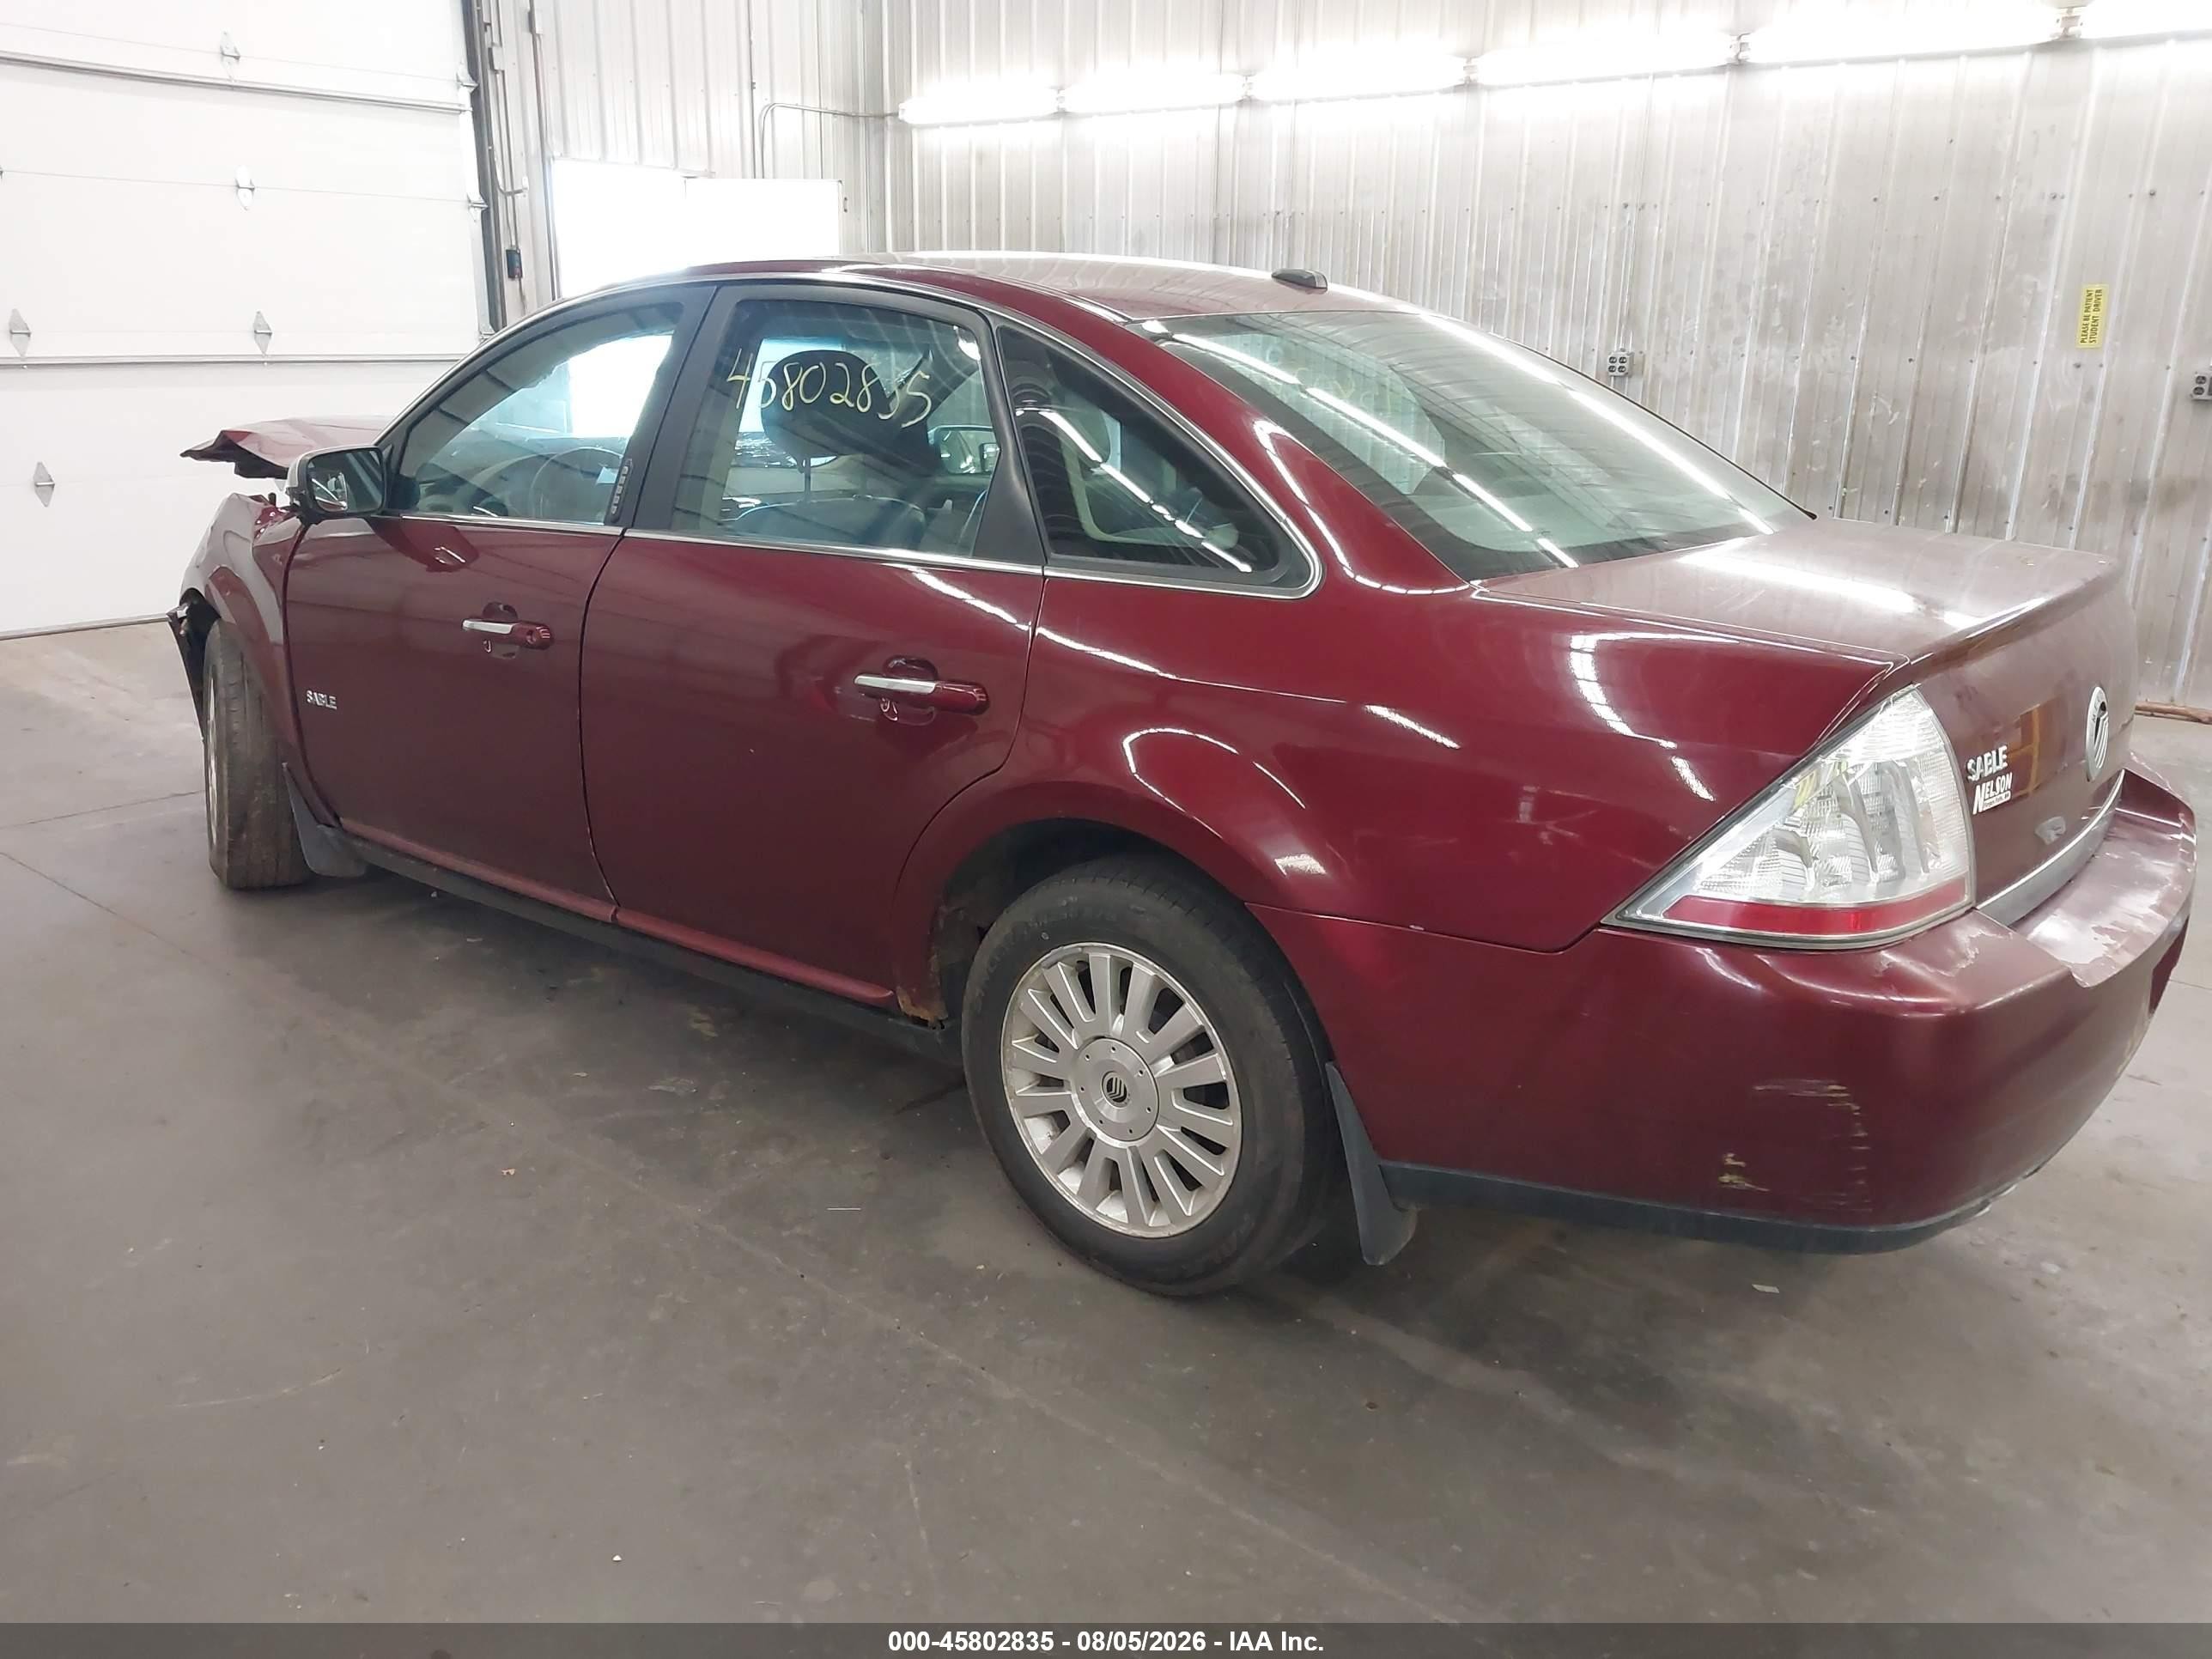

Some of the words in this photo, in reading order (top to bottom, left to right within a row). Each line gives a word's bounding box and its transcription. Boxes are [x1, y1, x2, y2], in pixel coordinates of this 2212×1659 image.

[2084, 289, 2094, 313] PATIENT
[2093, 289, 2103, 312] DRIVER
[2080, 322, 2089, 343] PLEASE
[2088, 315, 2100, 343] STUDENT
[1966, 744, 2008, 781] SABLE
[1972, 771, 2013, 815] NELSON
